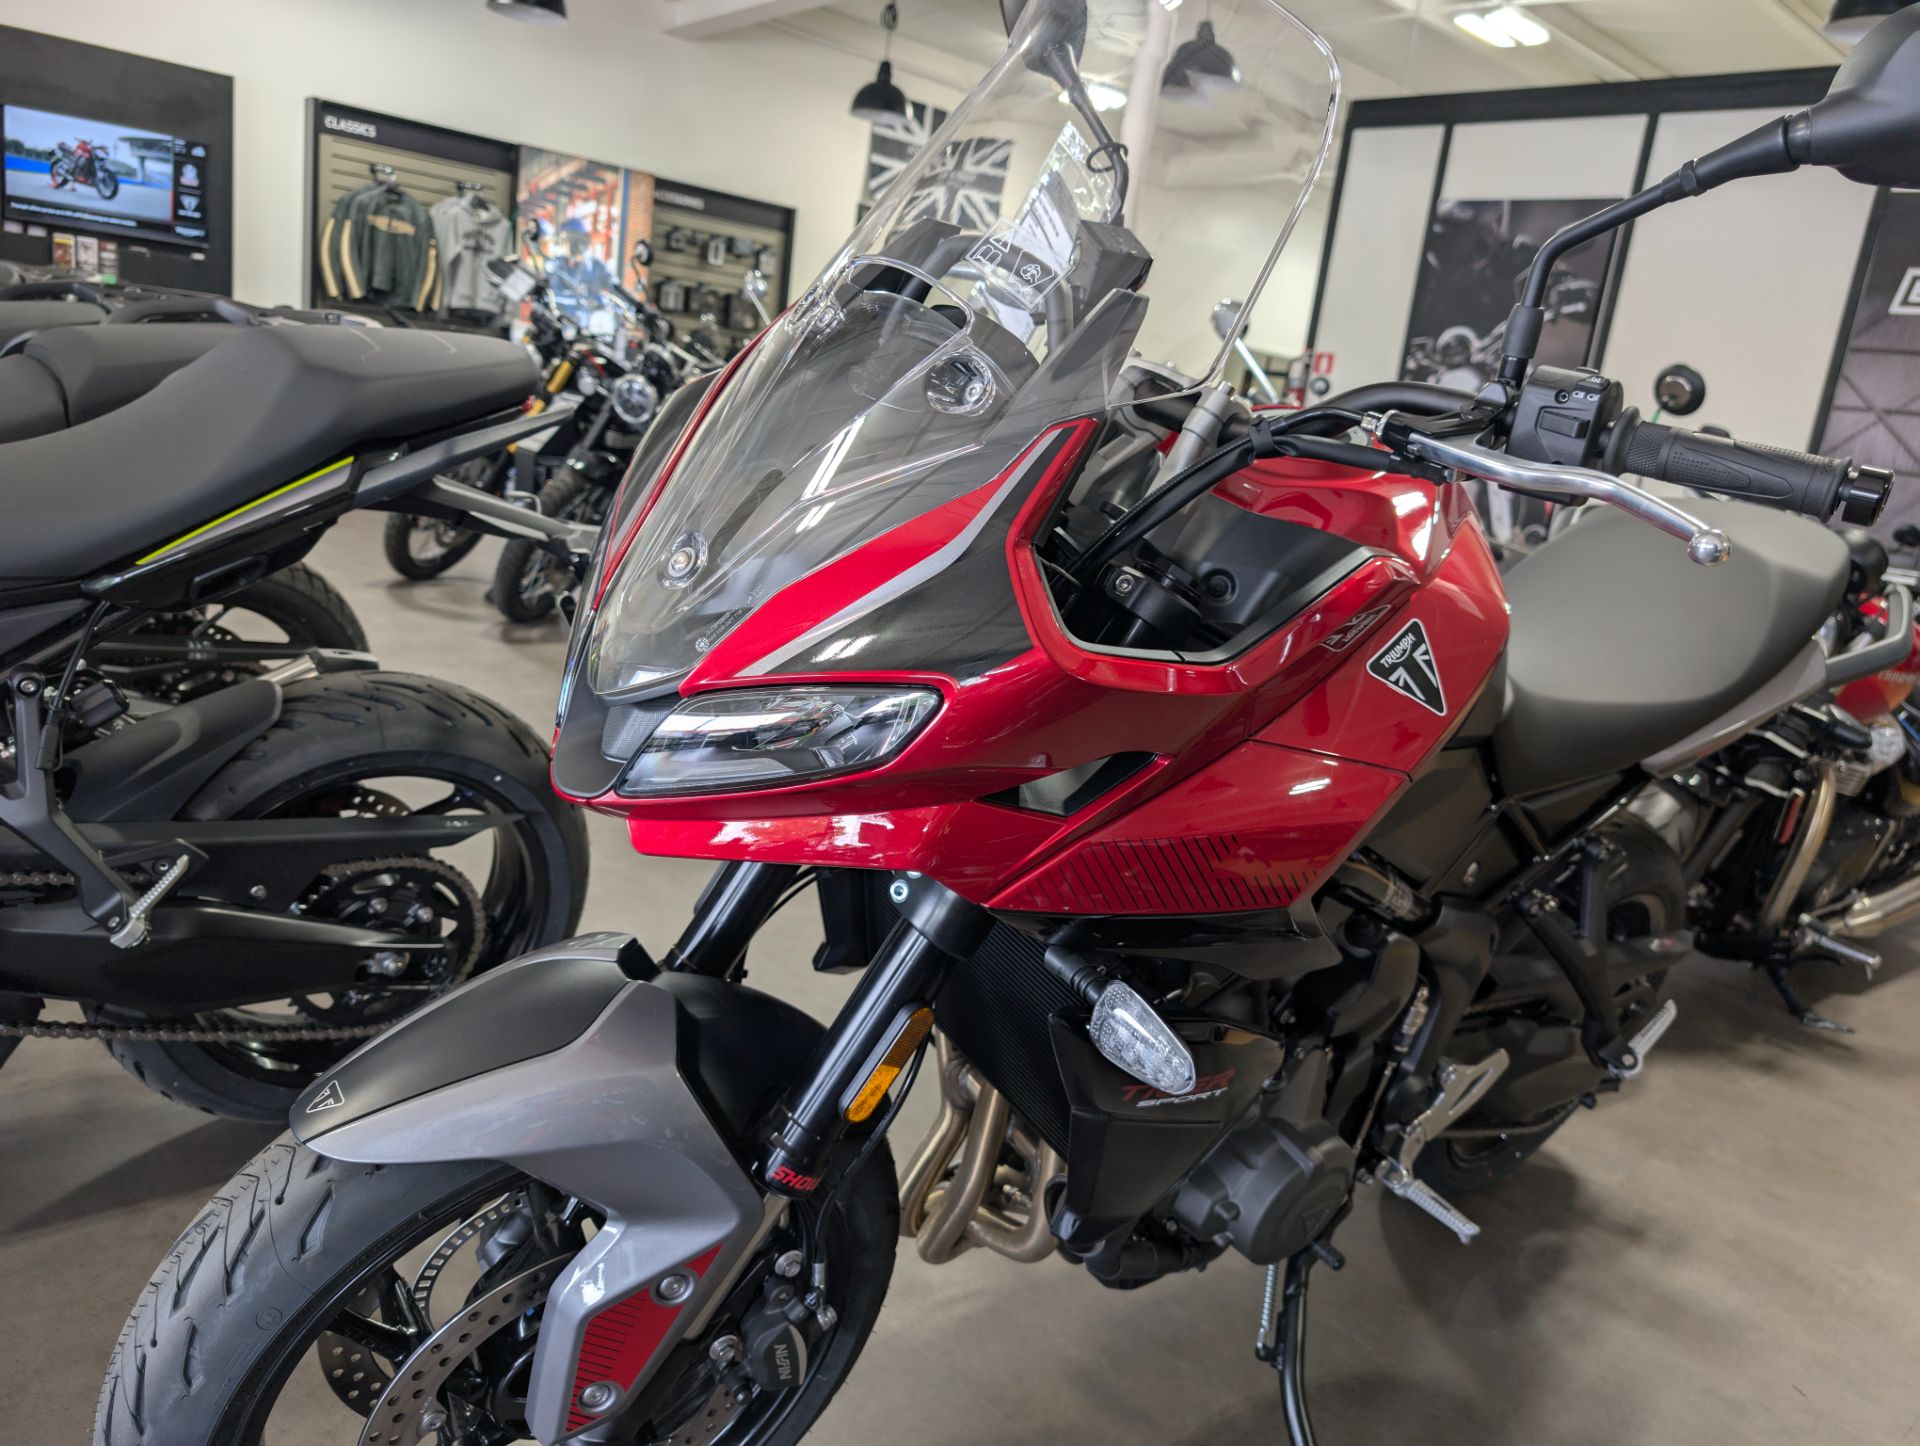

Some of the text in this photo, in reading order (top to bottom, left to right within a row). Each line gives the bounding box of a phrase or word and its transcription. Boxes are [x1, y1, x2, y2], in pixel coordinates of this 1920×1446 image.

[324, 114, 377, 138] CLASSICS
[1380, 632, 1417, 668] TRIUMPH
[1119, 1068, 1237, 1101] TIER
[1135, 1087, 1229, 1108] SPORT
